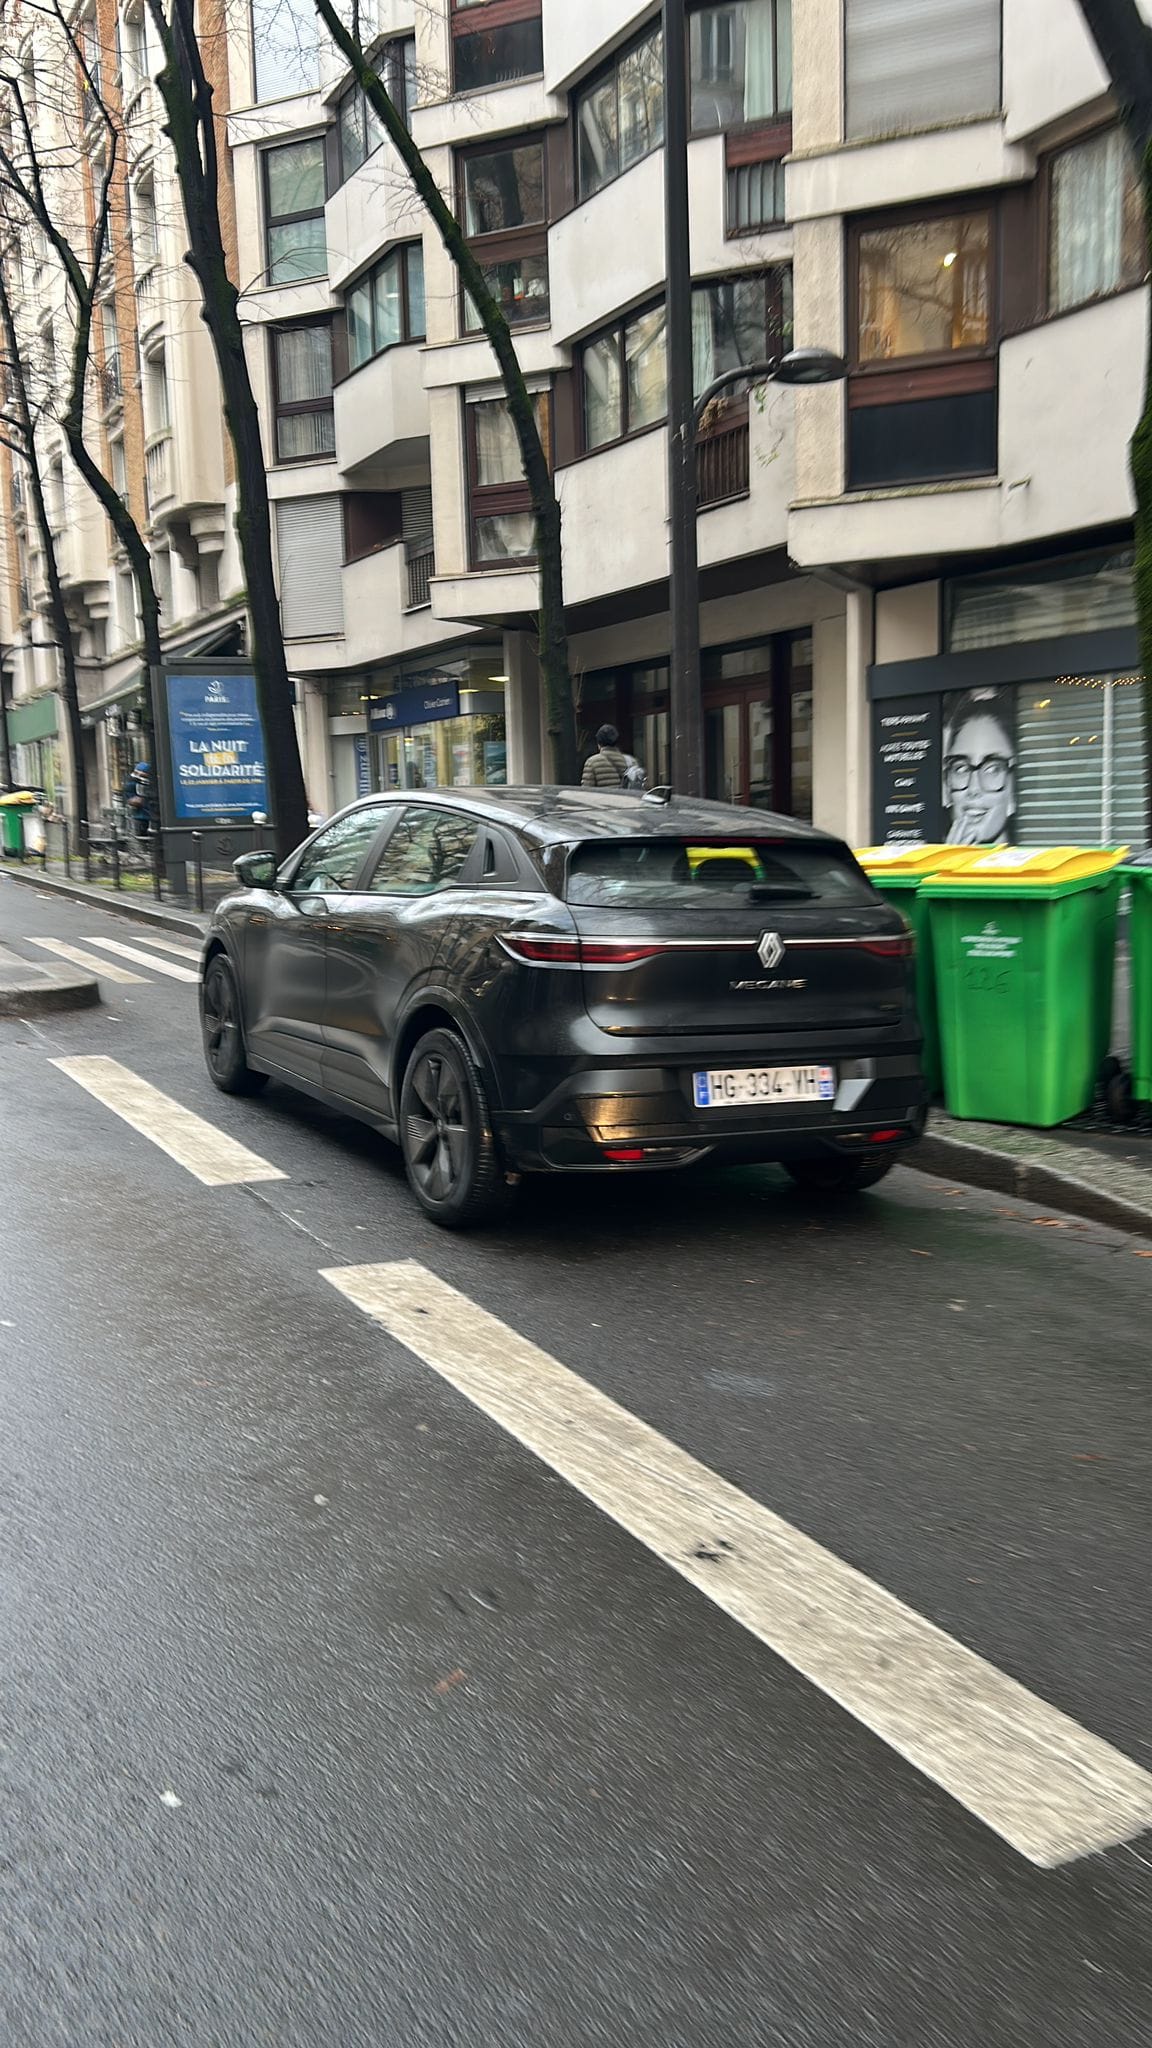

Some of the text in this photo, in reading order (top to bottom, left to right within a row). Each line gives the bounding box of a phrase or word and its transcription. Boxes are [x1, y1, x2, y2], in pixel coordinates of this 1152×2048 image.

[204, 695, 230, 704] PARIS
[189, 739, 249, 753] LA NUIT
[179, 761, 266, 777] SOLIDARITÉ
[728, 979, 809, 990] MEGANE
